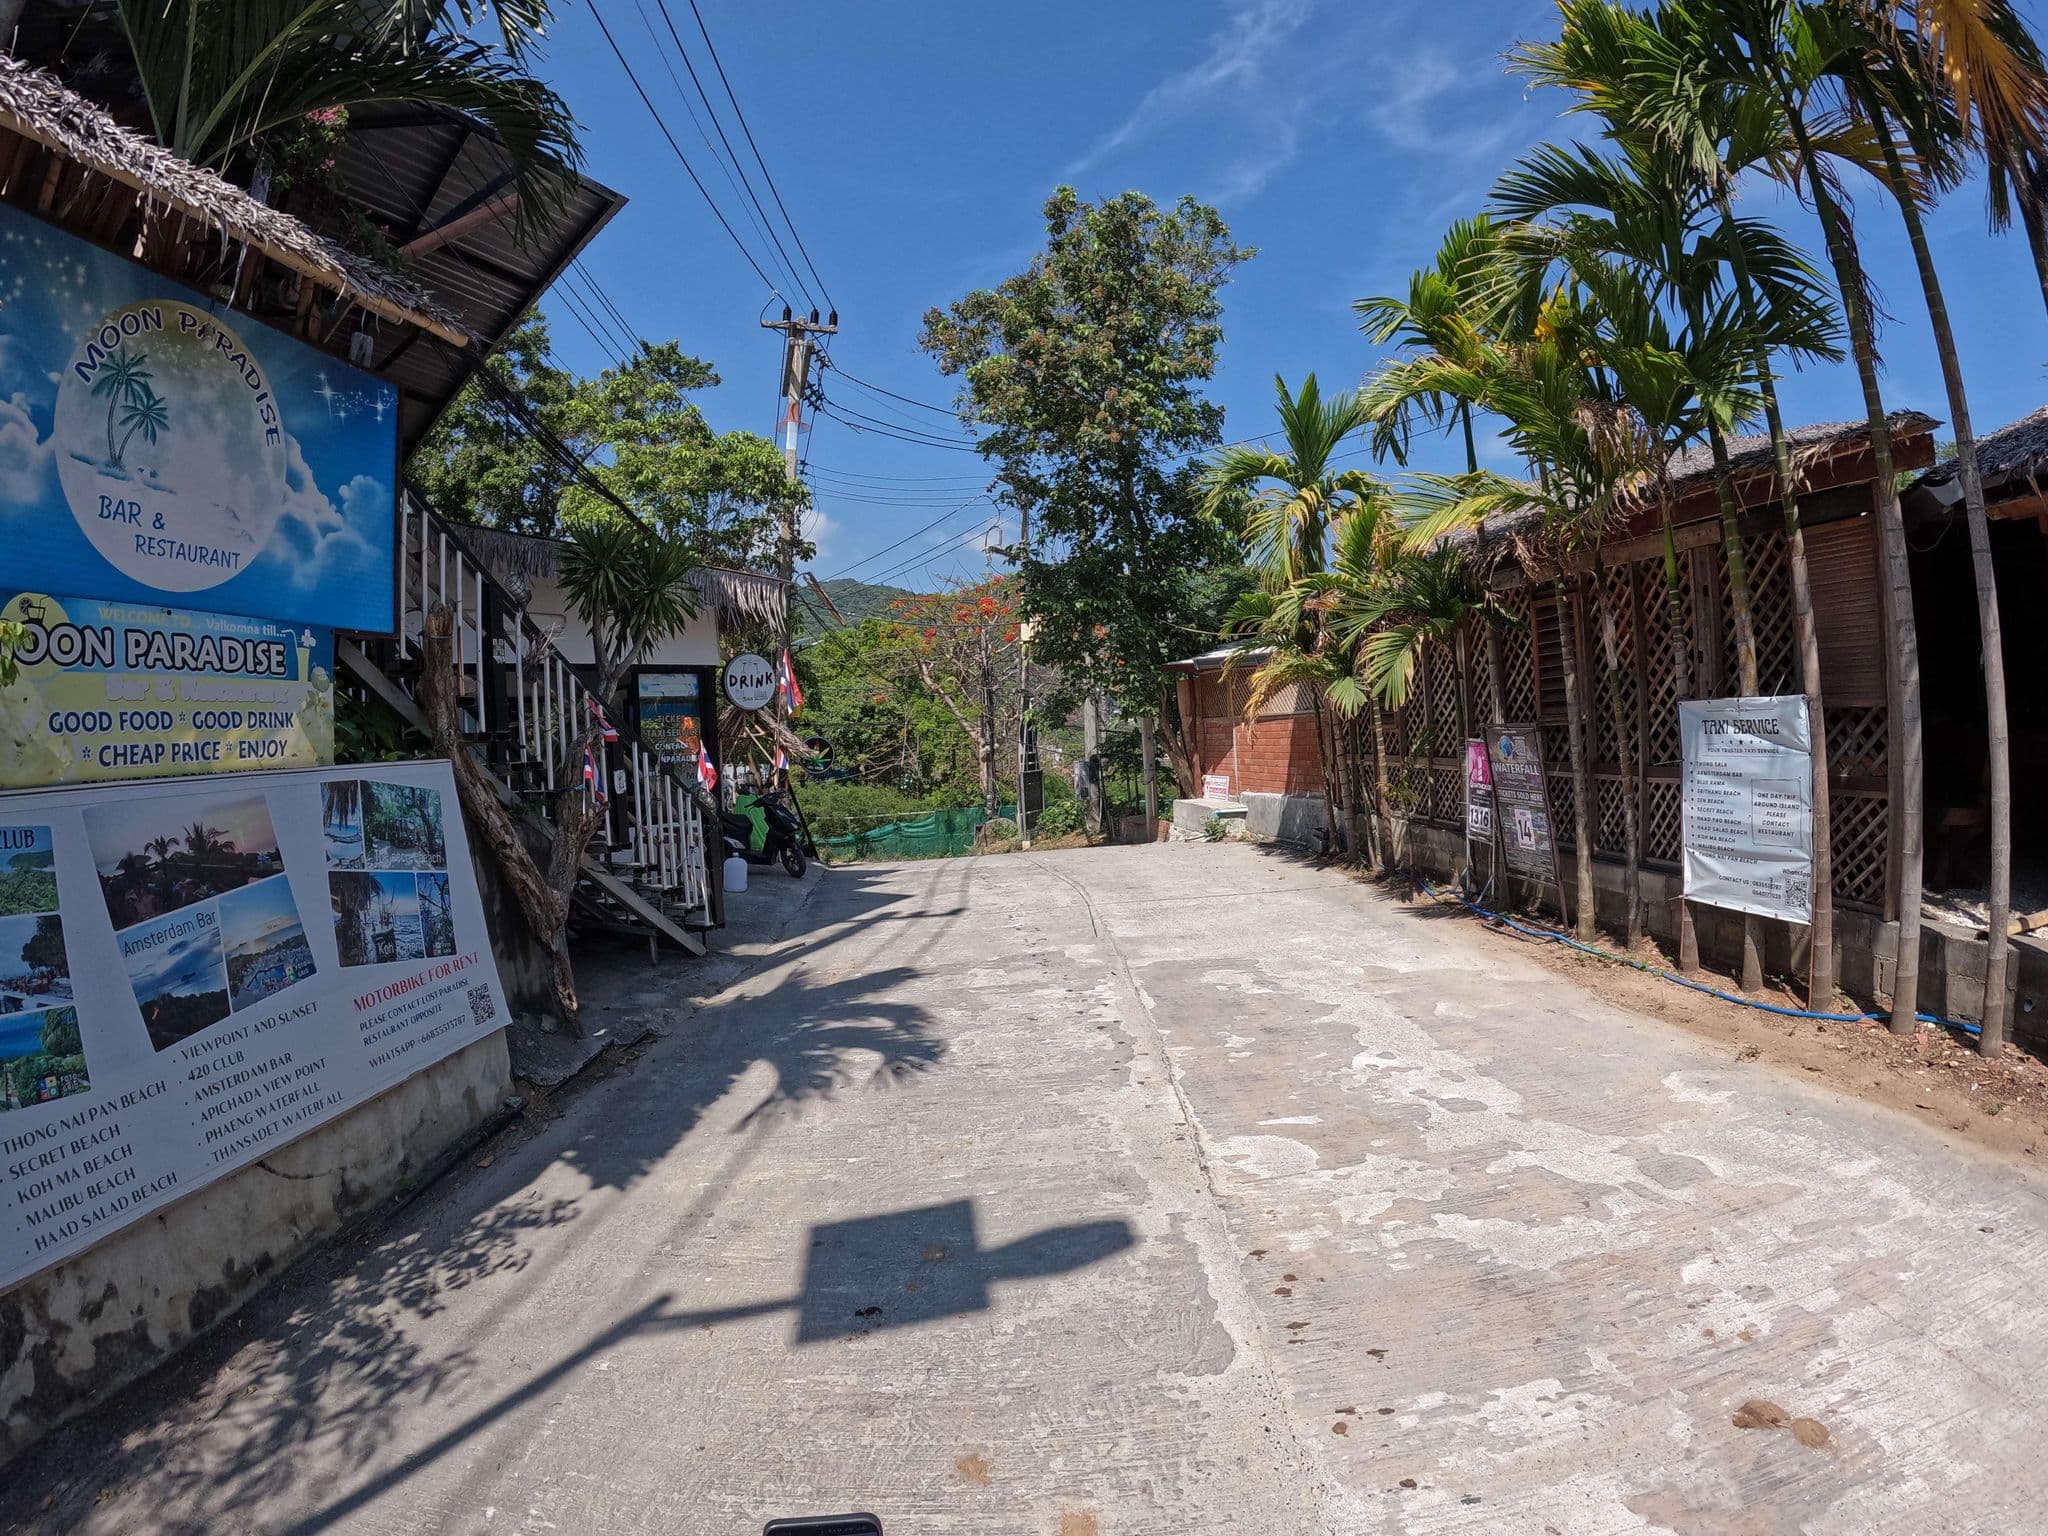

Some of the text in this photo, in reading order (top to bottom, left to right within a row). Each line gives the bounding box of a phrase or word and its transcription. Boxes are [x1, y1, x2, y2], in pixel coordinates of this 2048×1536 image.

[74, 306, 281, 447] MOON PARADISE
[98, 495, 166, 531] BAR &
[135, 534, 241, 570] RESTAURANT
[124, 628, 287, 676] PARADISE
[729, 671, 773, 689] DRINK
[48, 710, 294, 733] GOOD FOOD GOOD DRINK
[1701, 718, 1780, 735] TAXI SERVICE
[98, 739, 288, 767] CHEAP PRICE ENJOY
[1493, 762, 1540, 776] WATERFALL
[0, 829, 35, 849] LUB
[1518, 819, 1532, 842] 14
[1758, 829, 1795, 837] RESTAURANT
[124, 911, 216, 958] Amsterdam Bar
[353, 952, 479, 1013] MOTORBIKE FOR RENT
[359, 1012, 386, 1032] PLEASE
[388, 999, 420, 1020] CONTACT
[438, 977, 471, 997] PARADISE
[181, 1001, 319, 1061] VIEWPOINT AND SUNSET
[363, 1003, 443, 1047] RESTAURANT OPPOSITE
[187, 1050, 245, 1081] 420 CLUB
[193, 1052, 293, 1103] AMSTERDAM BAR
[368, 1039, 416, 1070] WHATSAPP
[200, 1057, 328, 1123] APICHADA VIEW POINT
[205, 1081, 321, 1144] PHAENG WATERFALL
[1, 1080, 167, 1156] THONG NAI PAN BEACH
[211, 1090, 345, 1163] THANSADET WATERFALL
[9, 1123, 121, 1180] SECRET BEACH
[17, 1143, 133, 1204] KOH MA BEACH
[25, 1167, 136, 1227] MALIBU BEACH
[34, 1171, 178, 1251] HAAD SALAD BEACH
